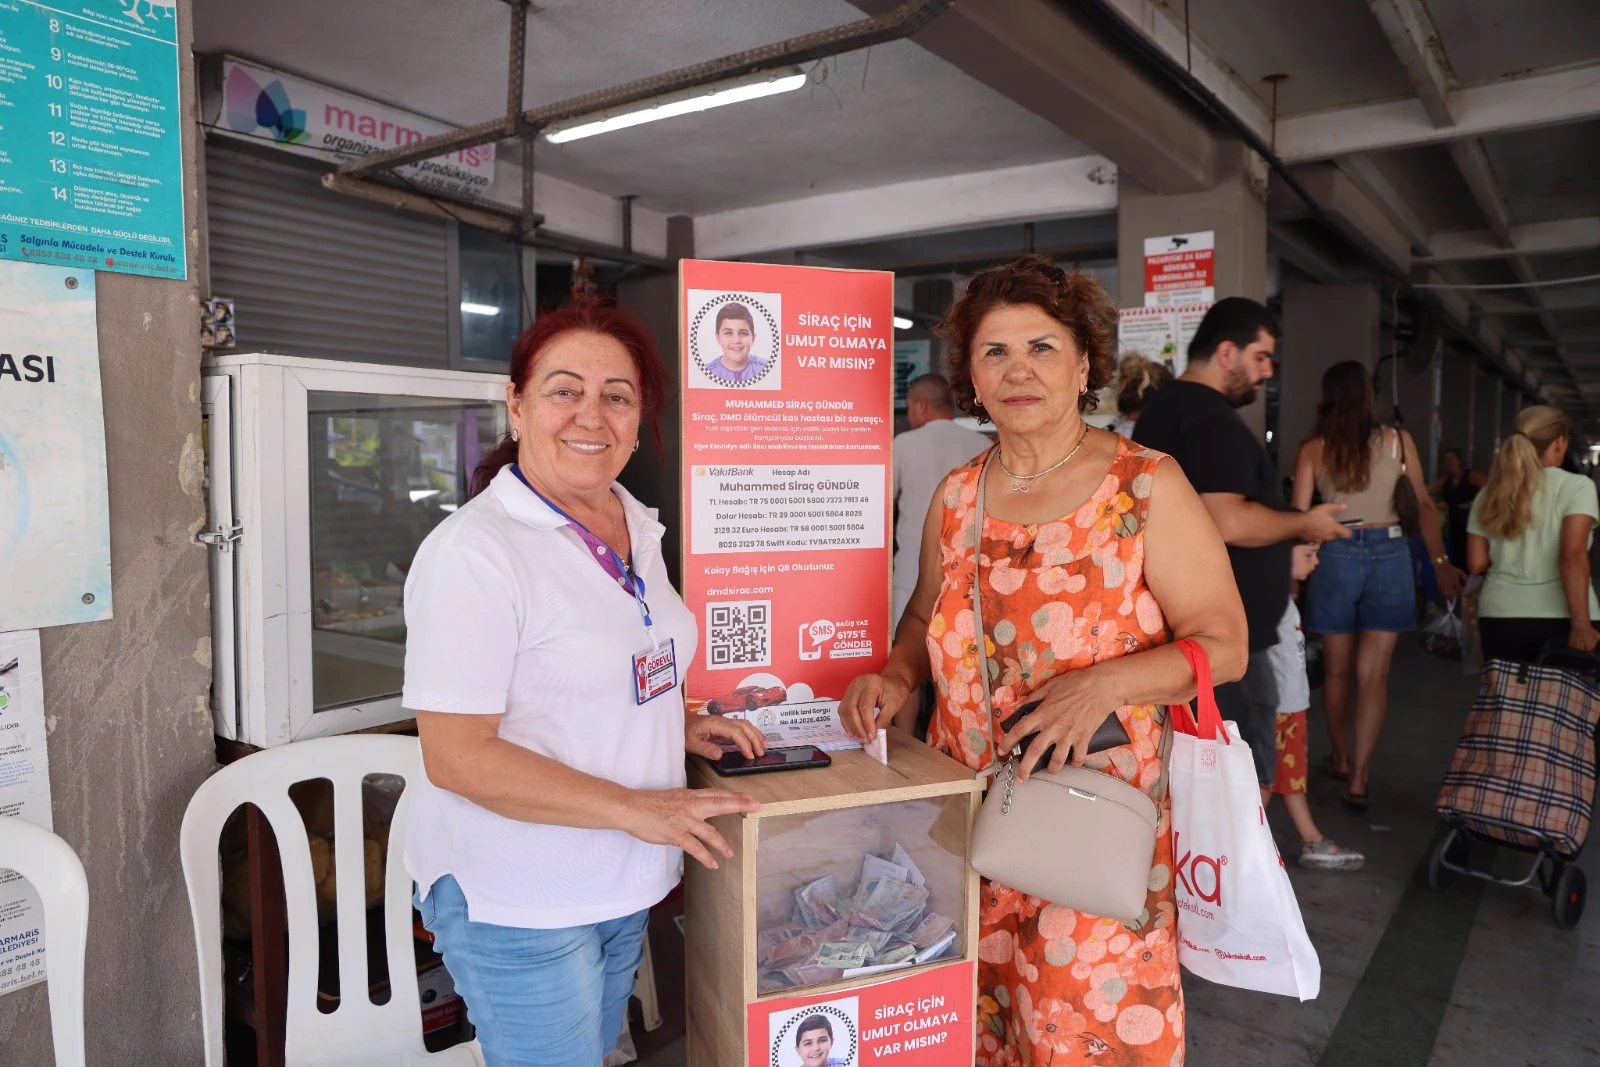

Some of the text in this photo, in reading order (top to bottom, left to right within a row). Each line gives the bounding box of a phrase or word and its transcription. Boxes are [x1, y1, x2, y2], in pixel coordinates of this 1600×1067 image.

[50, 18, 60, 33] 8
[50, 47, 61, 62] 9
[45, 74, 62, 90] 10
[48, 103, 62, 118] 11
[48, 131, 66, 146] 12
[50, 158, 67, 174] 13
[52, 187, 68, 201] 14
[30, 218, 88, 232] TEDBİRLERDEN
[92, 227, 112, 236] DAHA
[113, 230, 138, 240] GÜÇLÜ
[20, 234, 60, 248] Salgınla
[62, 240, 104, 254] Mücadele
[108, 246, 118, 255] ve
[120, 248, 147, 260] Destek
[150, 252, 176, 263] Kurulu
[798, 311, 872, 332] SİRAÇ İÇİN
[786, 334, 886, 350] UMUT OLMAYA
[0, 354, 55, 382] ASI
[798, 356, 875, 370] VAR MISIN?
[726, 399, 854, 411] MUHAMMED SİRAÇ GÜNDÜR
[692, 412, 718, 424] Siraç,
[743, 413, 781, 422] ölümcül
[782, 414, 798, 422] kas
[800, 414, 833, 422] hastası
[834, 414, 846, 422] bir
[848, 416, 884, 425] savaşçı.
[709, 468, 810, 477] VakıfBank Hesap Adı
[720, 480, 860, 493] Muhammed Siraç GÜNDÜR
[704, 563, 834, 576] Kolay Bağış için QR Okutunuz
[707, 586, 774, 596] dmdsirac.com
[812, 626, 832, 635] SMS
[834, 640, 872, 649] GÖNDER
[648, 650, 671, 671] GÖREVLİ
[874, 996, 944, 1020] SİRAÇ İÇİN
[862, 1012, 958, 1041] UMUT OLMAYA
[873, 1032, 947, 1058] VAR MISIN?
